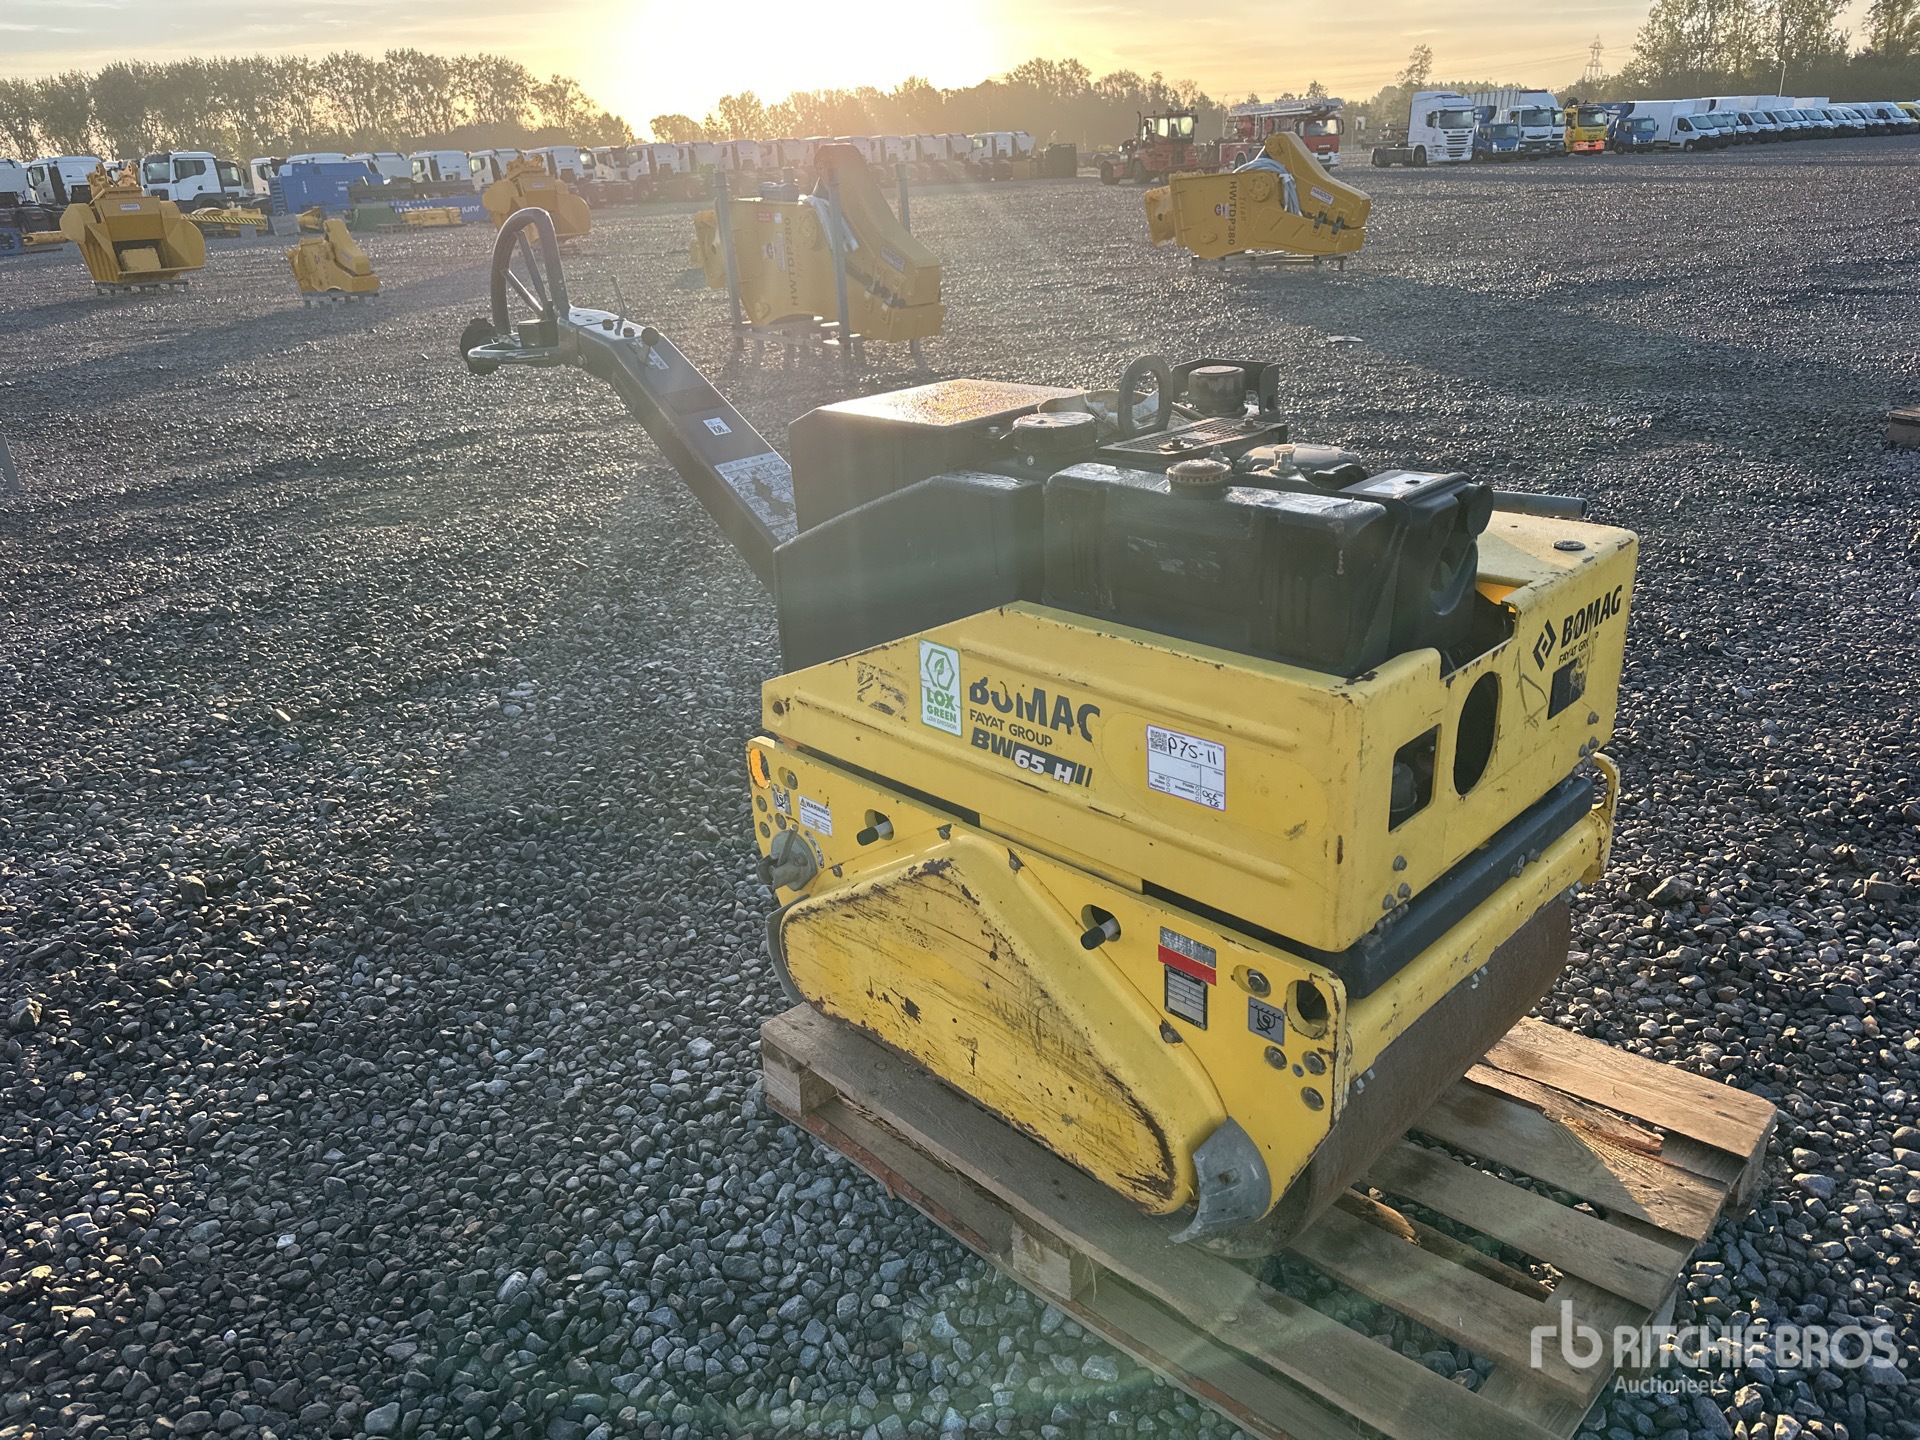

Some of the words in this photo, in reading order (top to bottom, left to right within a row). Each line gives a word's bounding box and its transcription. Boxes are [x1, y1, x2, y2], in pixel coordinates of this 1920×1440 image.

[1228, 181, 1237, 245] HWTDP380
[1561, 584, 1622, 649] BOMAG
[1559, 645, 1578, 665] FAYAT
[926, 687, 956, 711] LOX
[926, 704, 957, 724] GREEN
[970, 709, 1005, 731] FAYAT
[1009, 723, 1053, 747] GROUP
[1053, 762, 1073, 784] H
[806, 801, 830, 816] WARNING
